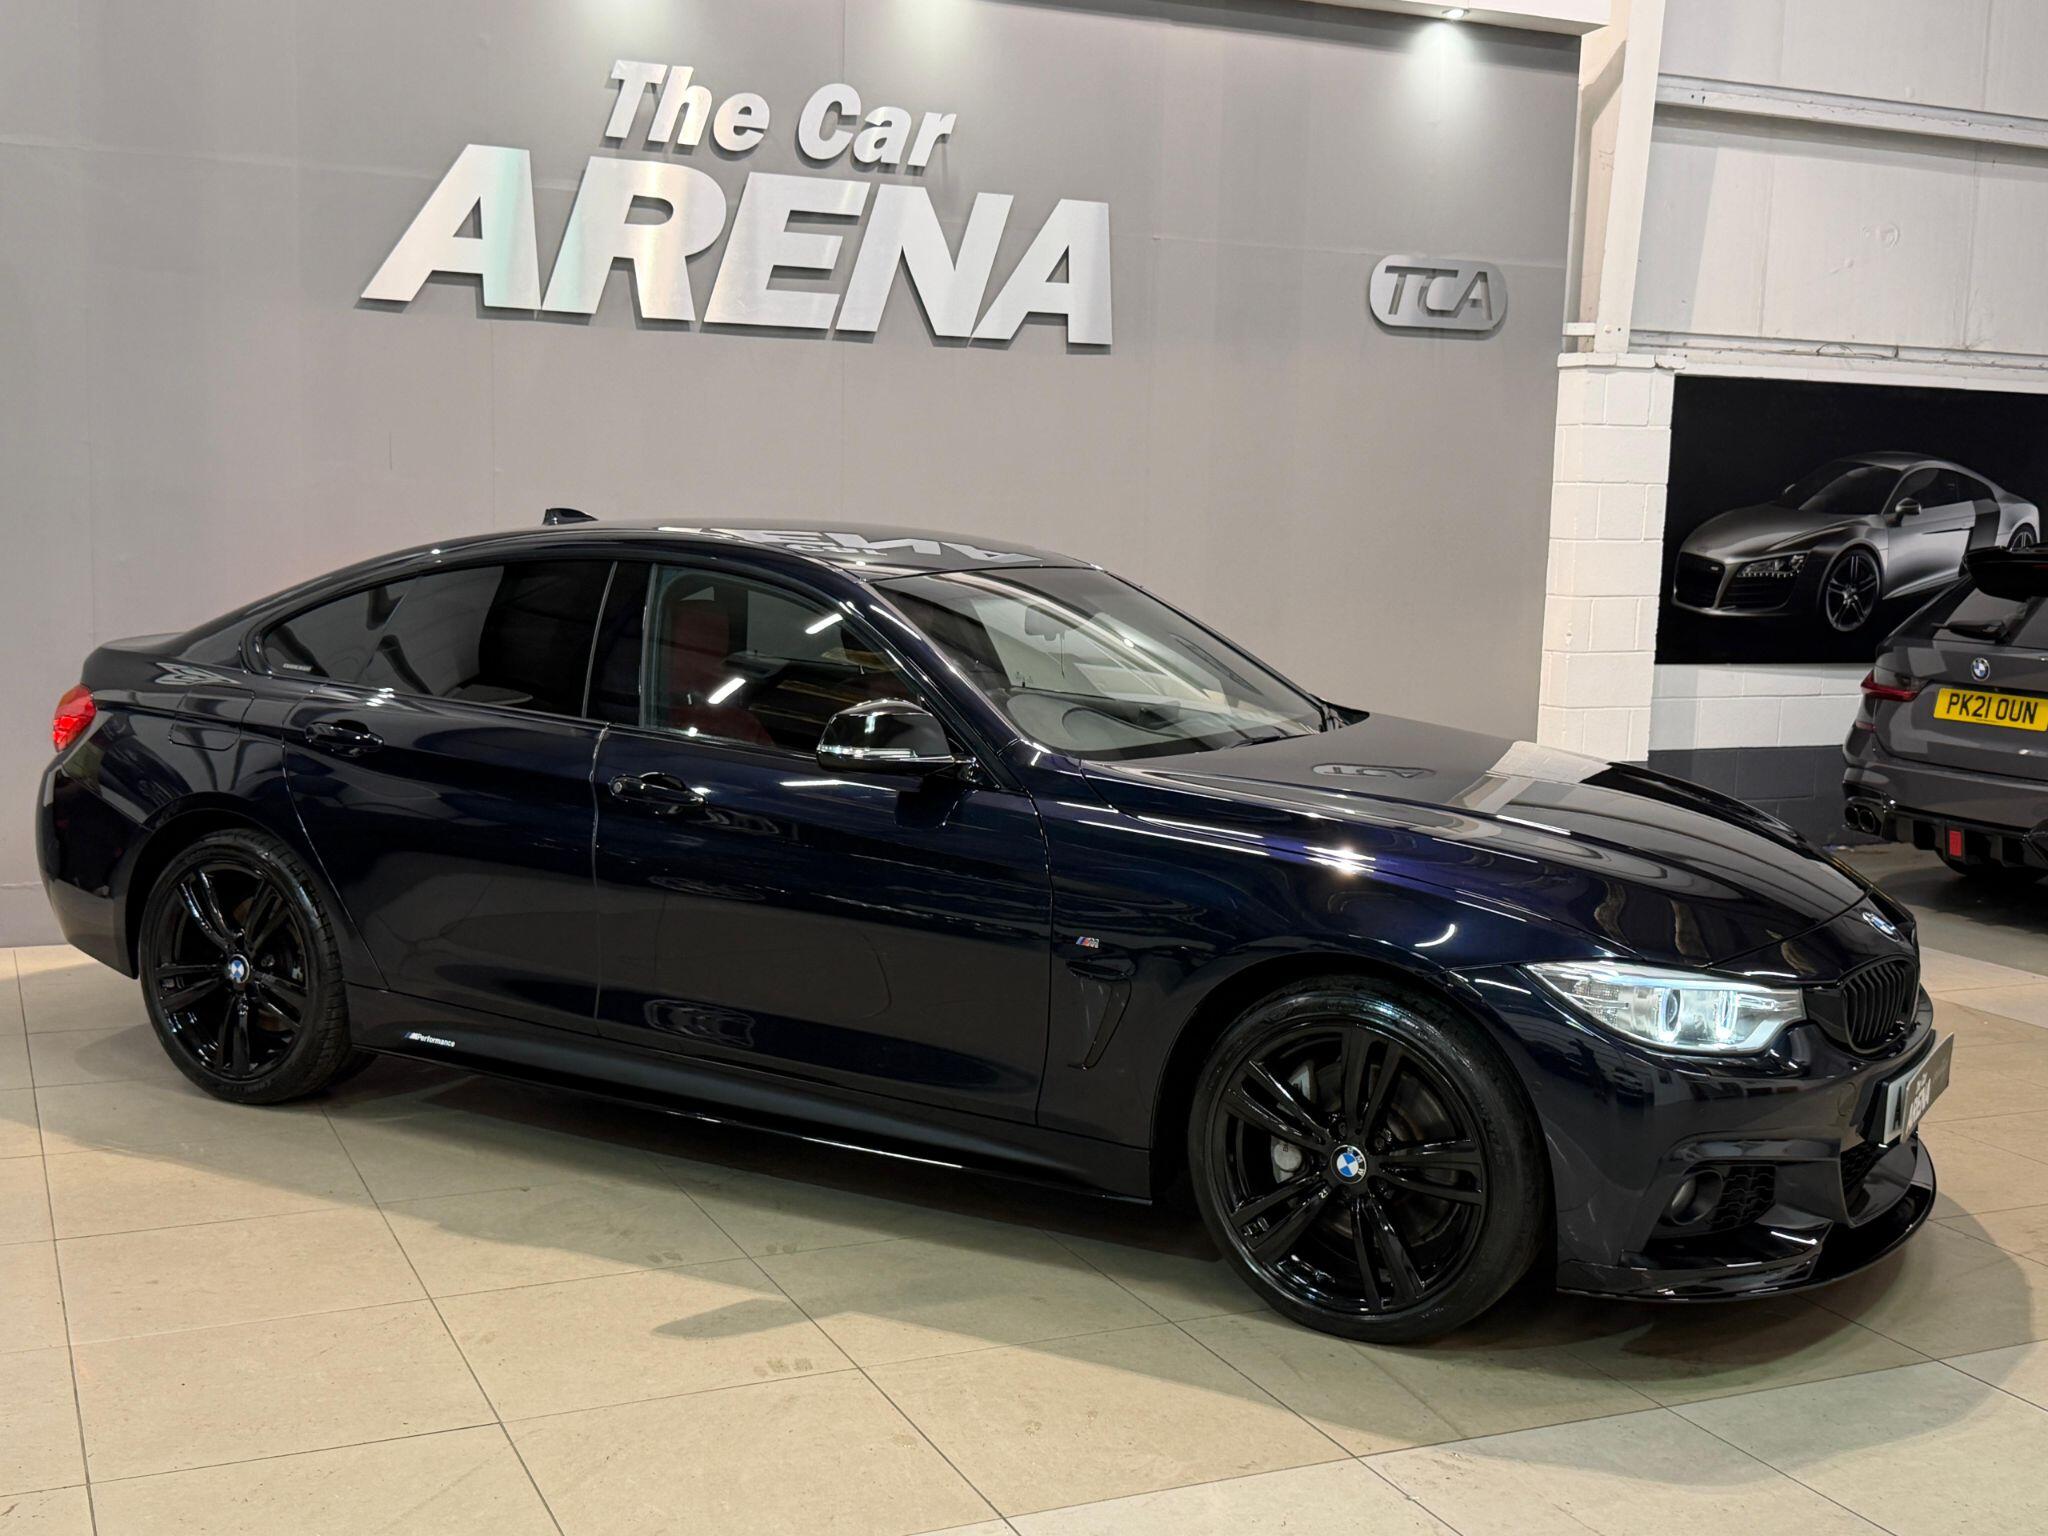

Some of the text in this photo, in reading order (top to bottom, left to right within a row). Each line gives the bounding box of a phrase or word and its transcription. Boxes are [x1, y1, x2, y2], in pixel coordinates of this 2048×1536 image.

[604, 59, 957, 167] The Car
[360, 143, 1113, 346] ARENA
[1384, 265, 1493, 321] TCA
[1946, 692, 2039, 725] PK21 OUN
